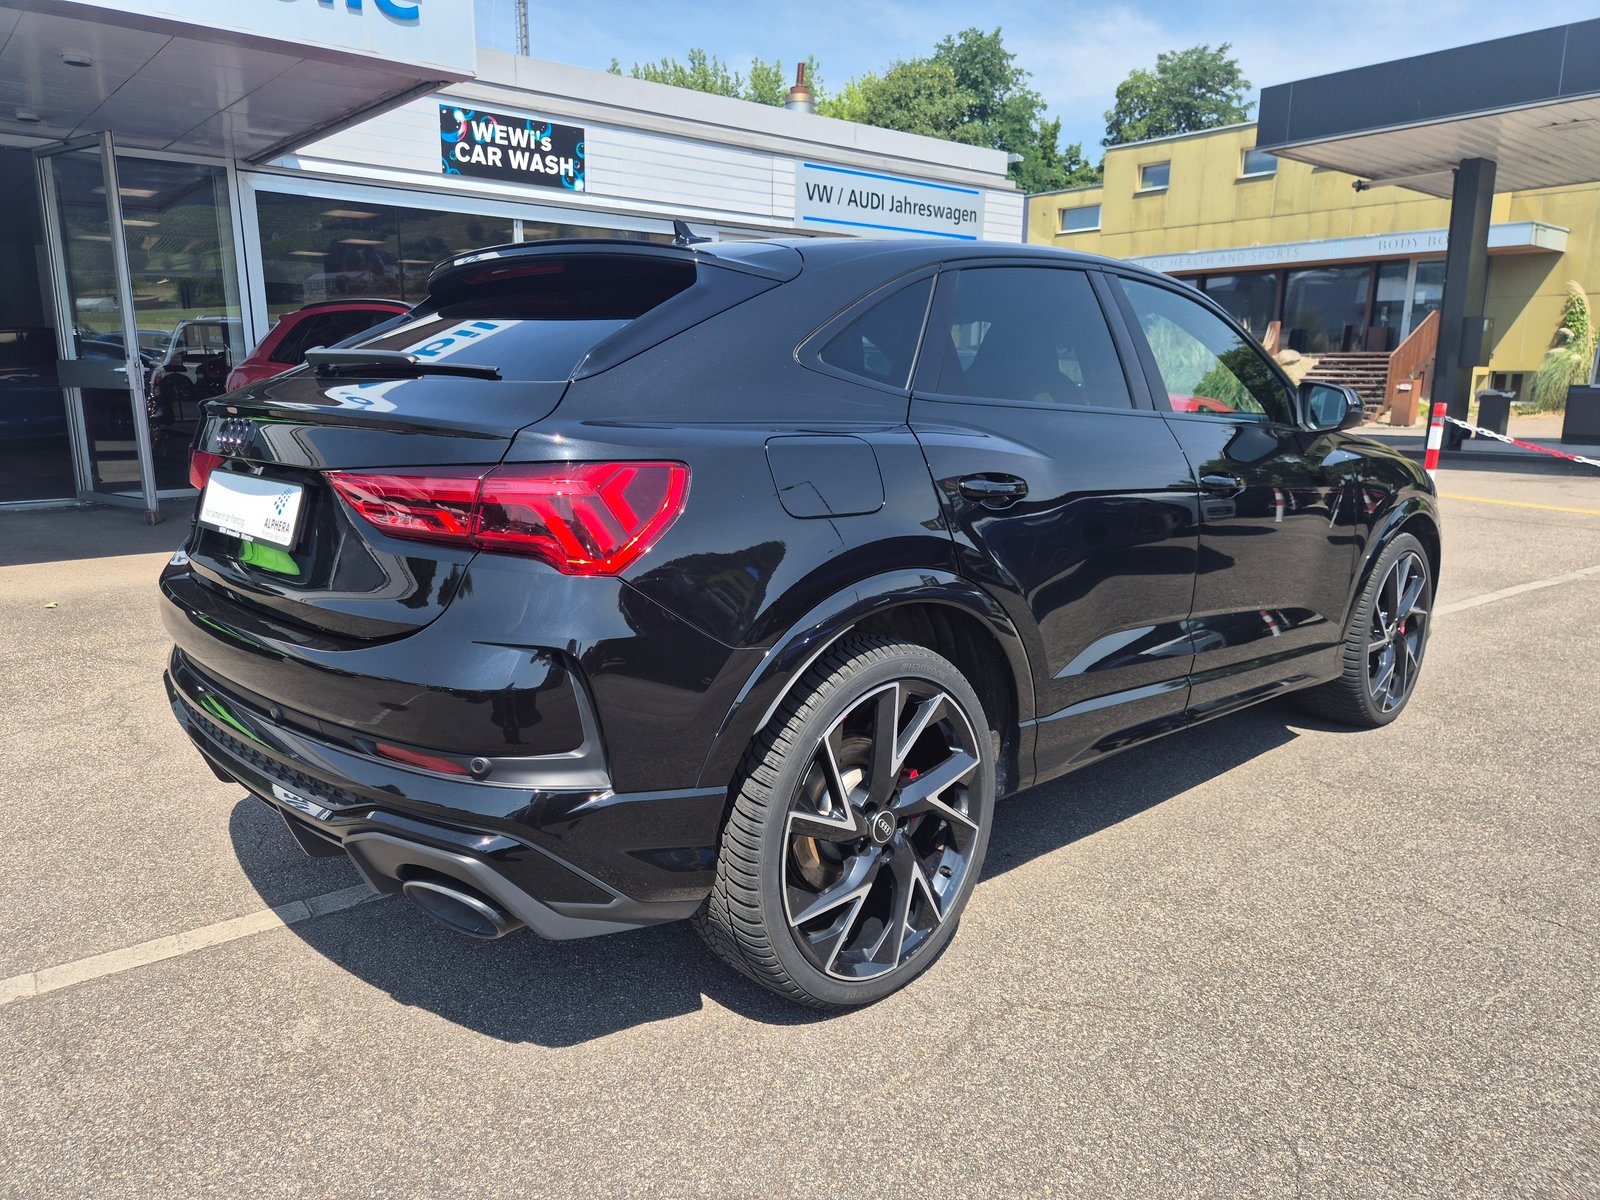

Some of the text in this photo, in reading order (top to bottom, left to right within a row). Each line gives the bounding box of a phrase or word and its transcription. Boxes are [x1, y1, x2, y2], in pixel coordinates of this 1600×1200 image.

[471, 120, 552, 152] WEWi's
[454, 141, 574, 177] CAR WASH
[805, 182, 977, 226] VW / AUDI Jahreswagen
[1377, 237, 1418, 251] BODY
[1150, 259, 1164, 269] OF
[1170, 255, 1214, 268] HEALTH
[1219, 252, 1245, 263] AND
[1251, 248, 1300, 262] SPORTS
[264, 517, 290, 534] ALPHERA
